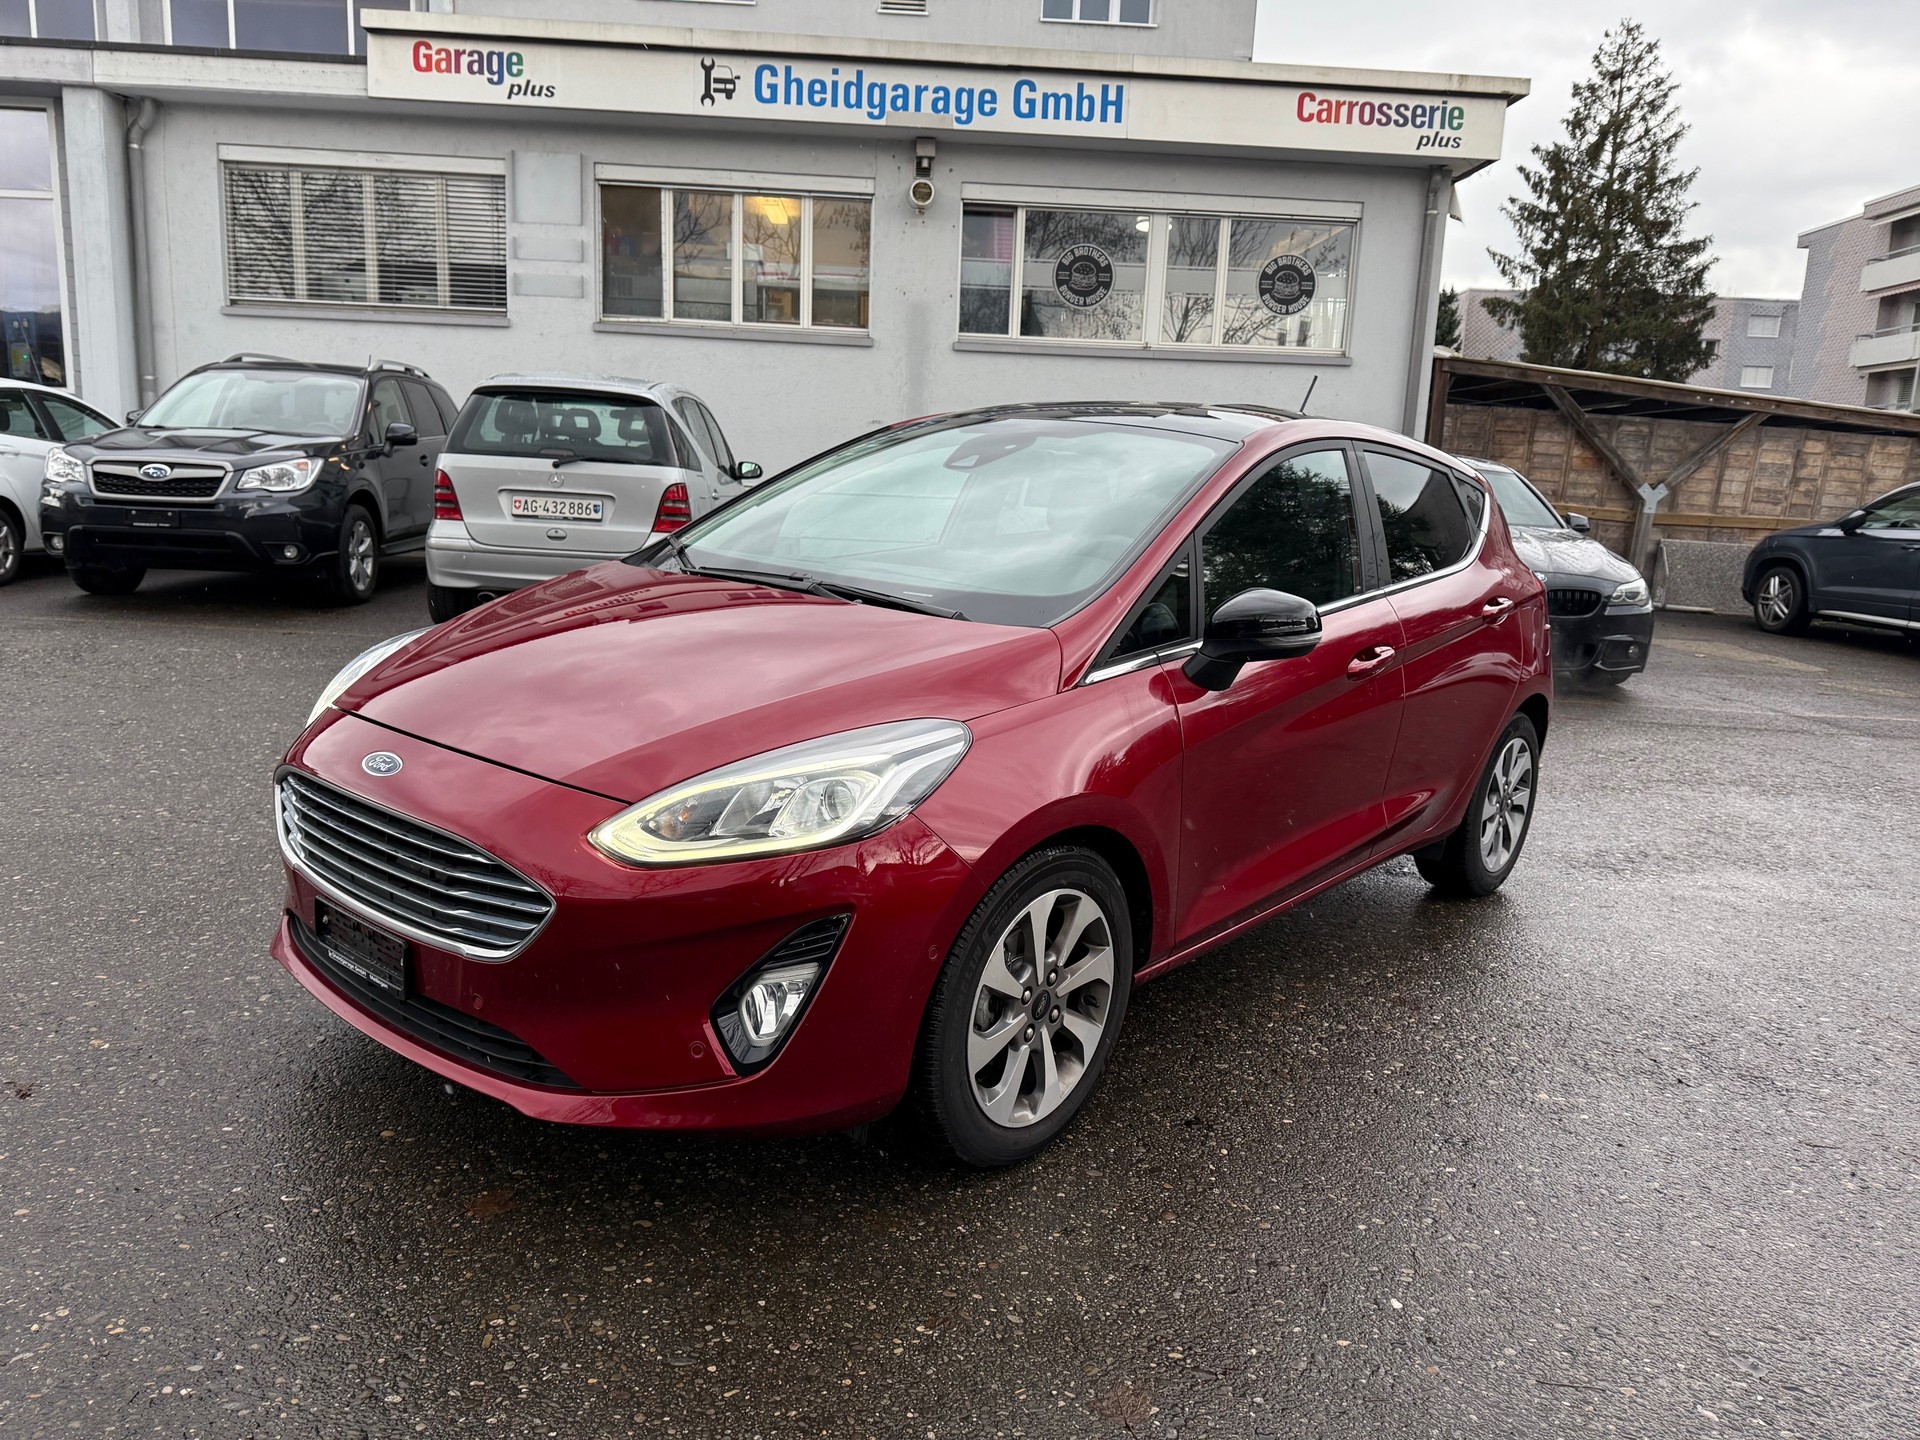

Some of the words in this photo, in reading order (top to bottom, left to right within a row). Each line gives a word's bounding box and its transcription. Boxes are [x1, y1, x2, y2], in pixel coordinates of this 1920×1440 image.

[412, 40, 524, 85] Garage
[507, 79, 556, 99] plus
[754, 63, 998, 125] Gheidgarage
[1013, 79, 1124, 124] GmbH
[1296, 92, 1465, 131] Carrosserie
[1416, 131, 1462, 150] plus
[1061, 252, 1074, 266] BIG
[1073, 246, 1109, 268] BROTHERS
[1264, 261, 1278, 275] BIG
[1277, 256, 1312, 276] BROTHERS
[1059, 284, 1085, 306] BURGER
[1085, 286, 1108, 305] HOUSE
[1262, 293, 1287, 314] BURGER
[1287, 294, 1310, 313] HOUSE
